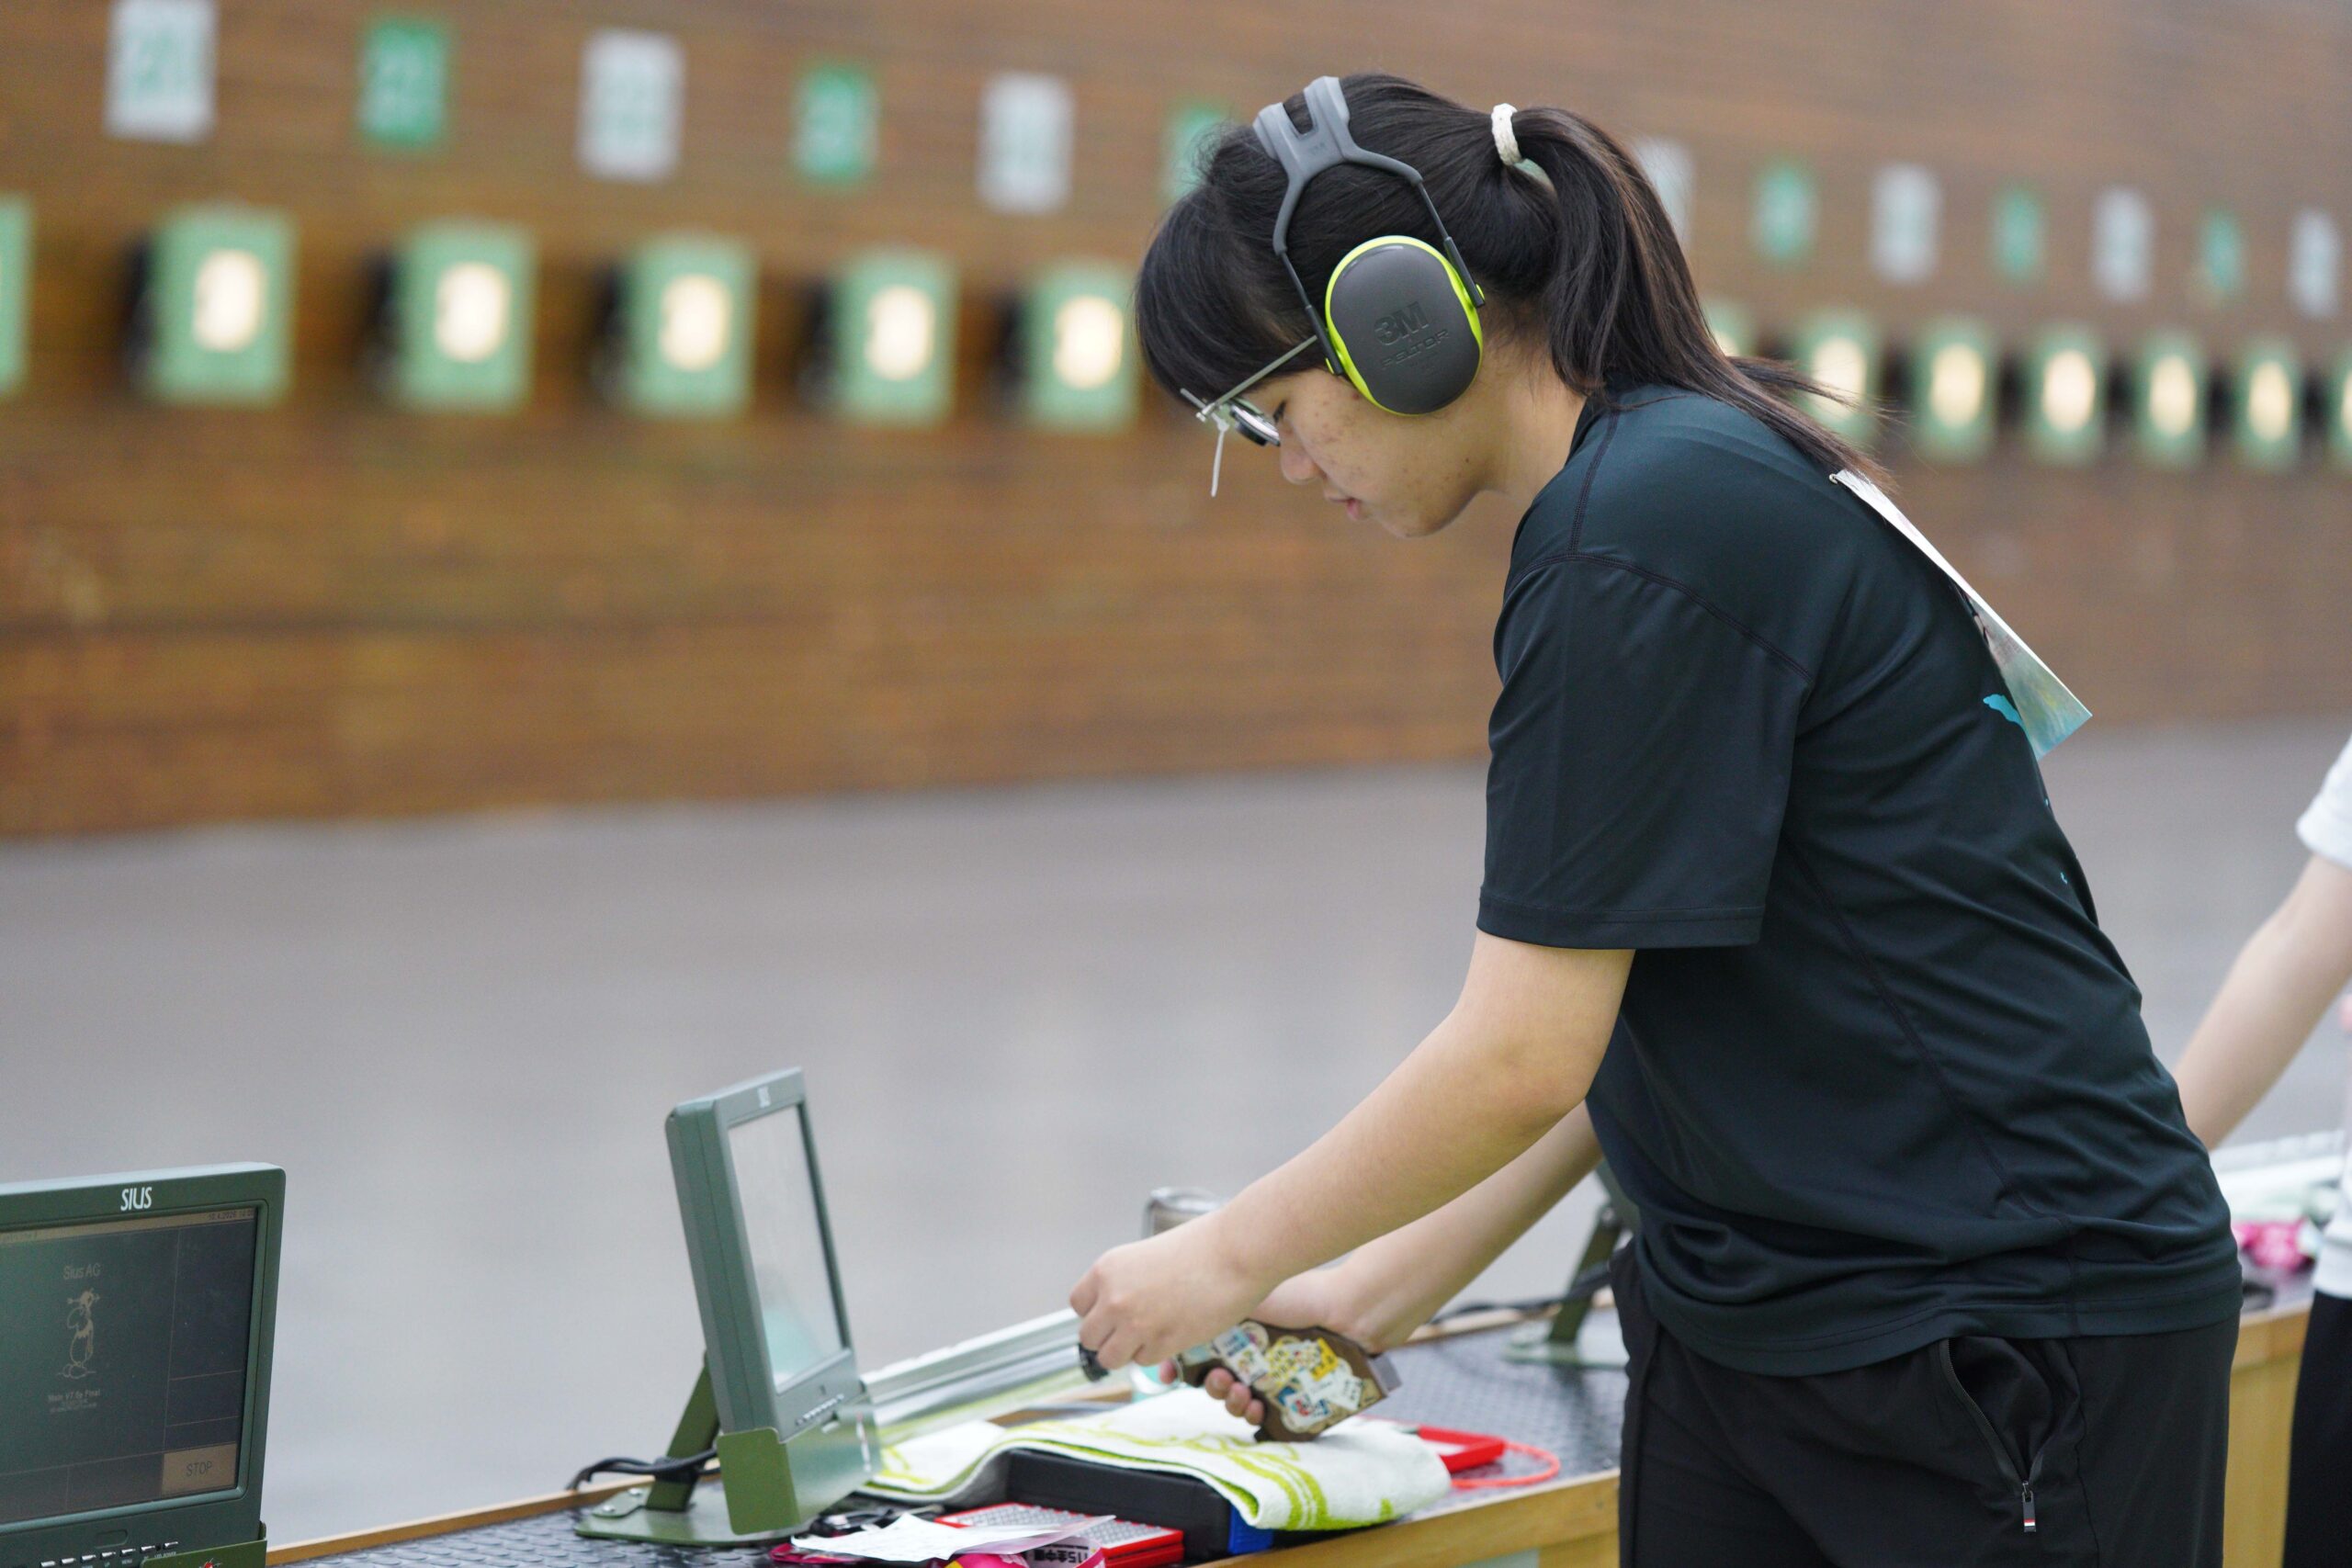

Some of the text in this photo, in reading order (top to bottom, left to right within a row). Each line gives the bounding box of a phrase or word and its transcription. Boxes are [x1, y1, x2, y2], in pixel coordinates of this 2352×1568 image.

[1374, 301, 1430, 346] 3M
[120, 1186, 153, 1212] SIUS
[187, 1461, 212, 1477] STOP
